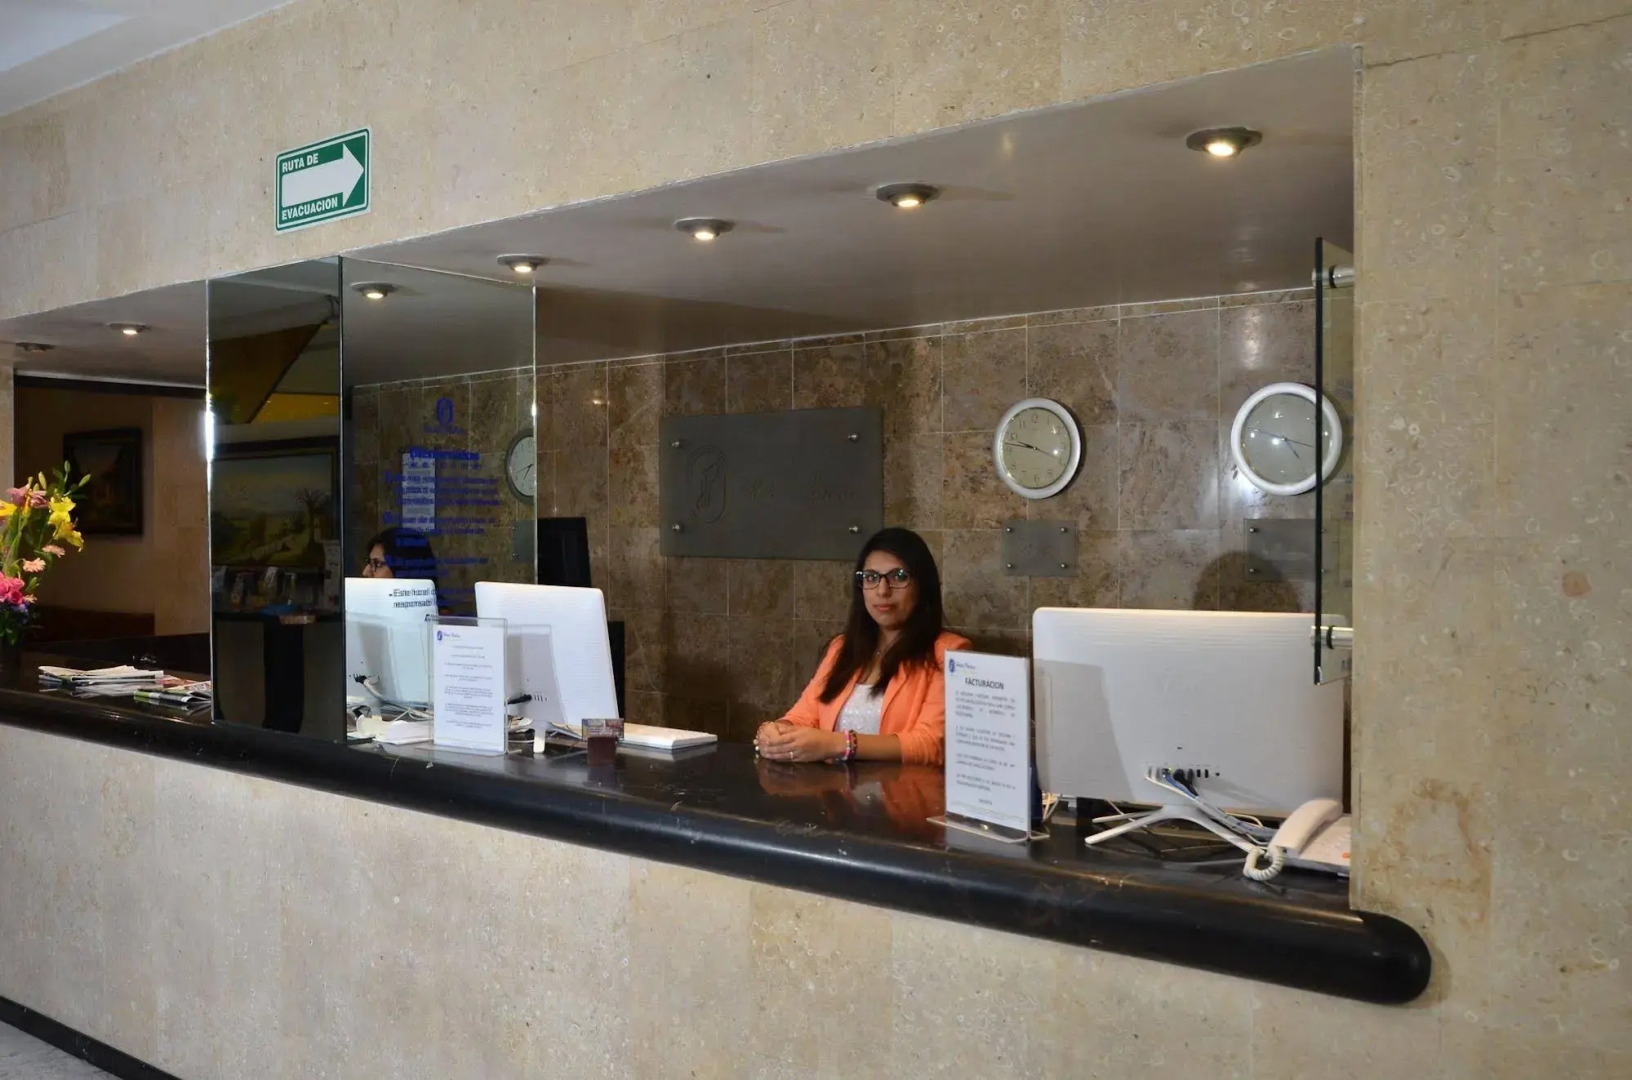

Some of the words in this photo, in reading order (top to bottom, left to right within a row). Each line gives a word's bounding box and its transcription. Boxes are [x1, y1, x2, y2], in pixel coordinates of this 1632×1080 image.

[282, 158, 305, 173] RUTA
[306, 153, 319, 166] DE
[281, 197, 338, 221] EVACUACION
[965, 677, 1005, 690] FACTURACION
